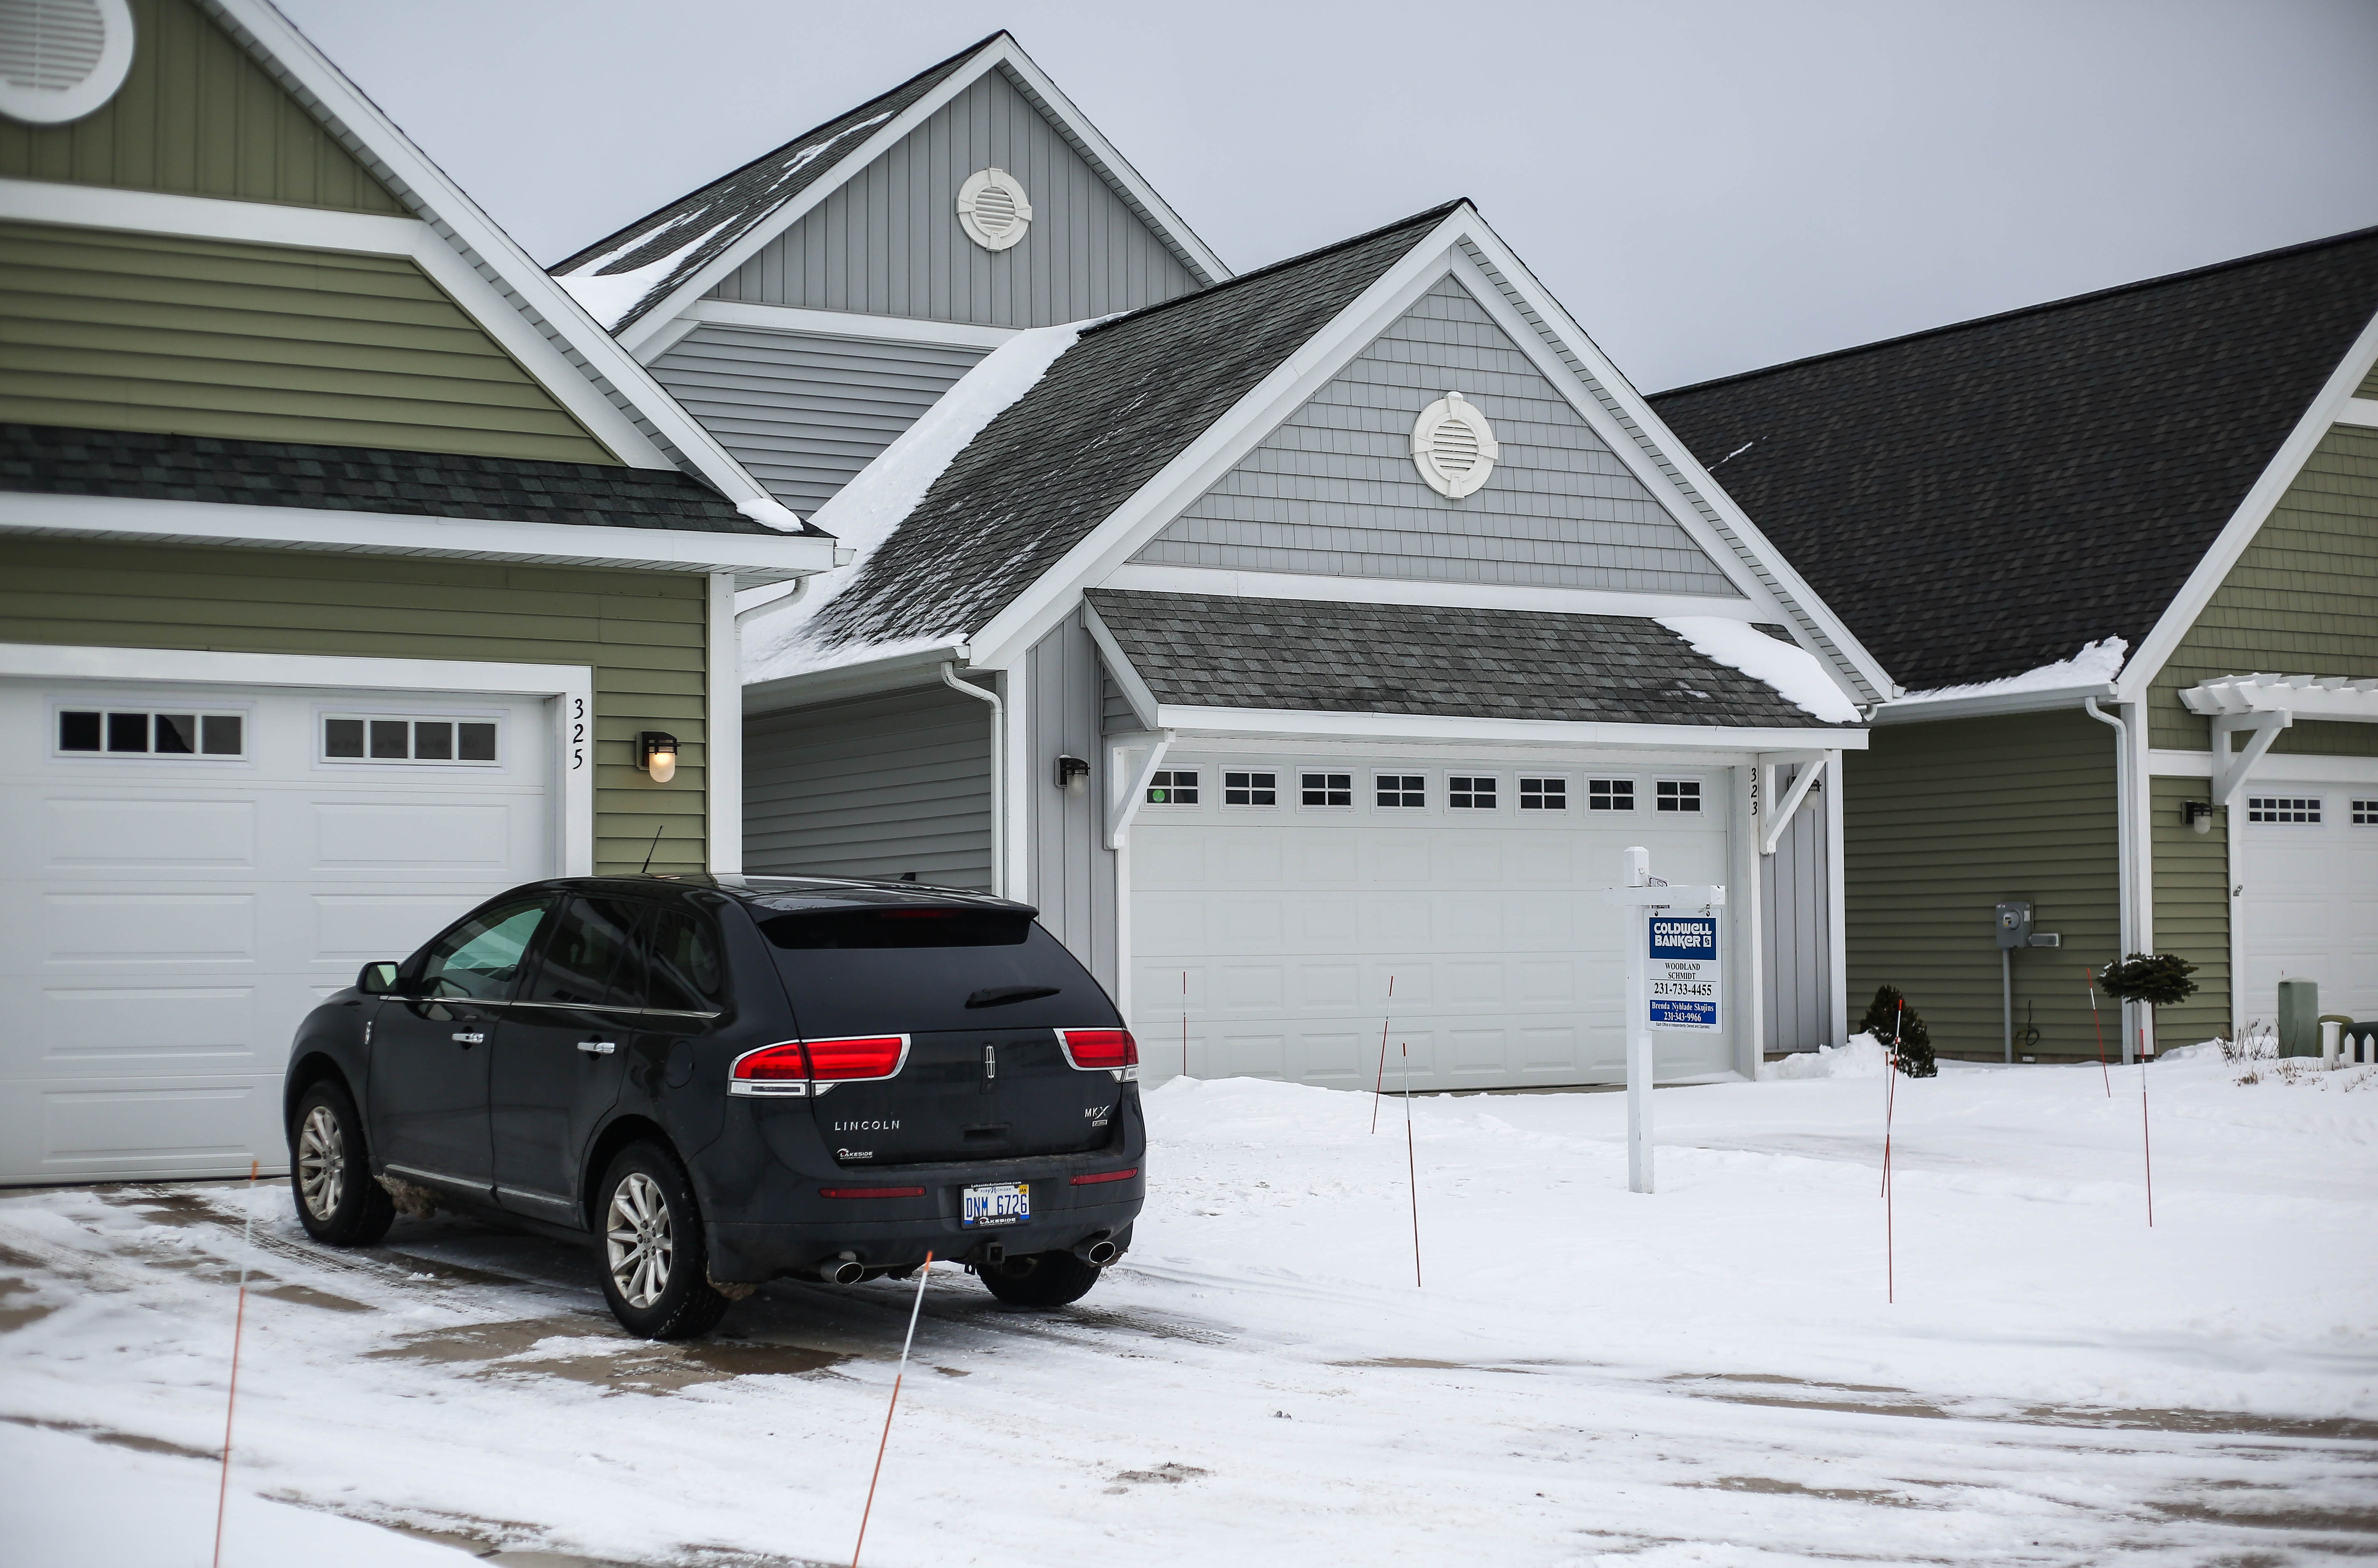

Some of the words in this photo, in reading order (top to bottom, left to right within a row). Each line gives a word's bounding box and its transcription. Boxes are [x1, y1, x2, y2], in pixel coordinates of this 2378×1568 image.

[572, 698, 583, 769] 325
[1654, 923, 1712, 935] COLDWELL
[1655, 935, 1701, 949] BANKER
[1654, 983, 1712, 996] 231-733-4455
[1672, 1003, 1693, 1011] Nyblade
[1694, 1003, 1714, 1013] Skujins
[1664, 1012, 1701, 1022] 231-343-9966
[1085, 1105, 1110, 1119] MKX
[835, 1120, 899, 1131] LINCOLN
[966, 1196, 988, 1217] DNM
[997, 1194, 1027, 1215] 6726
